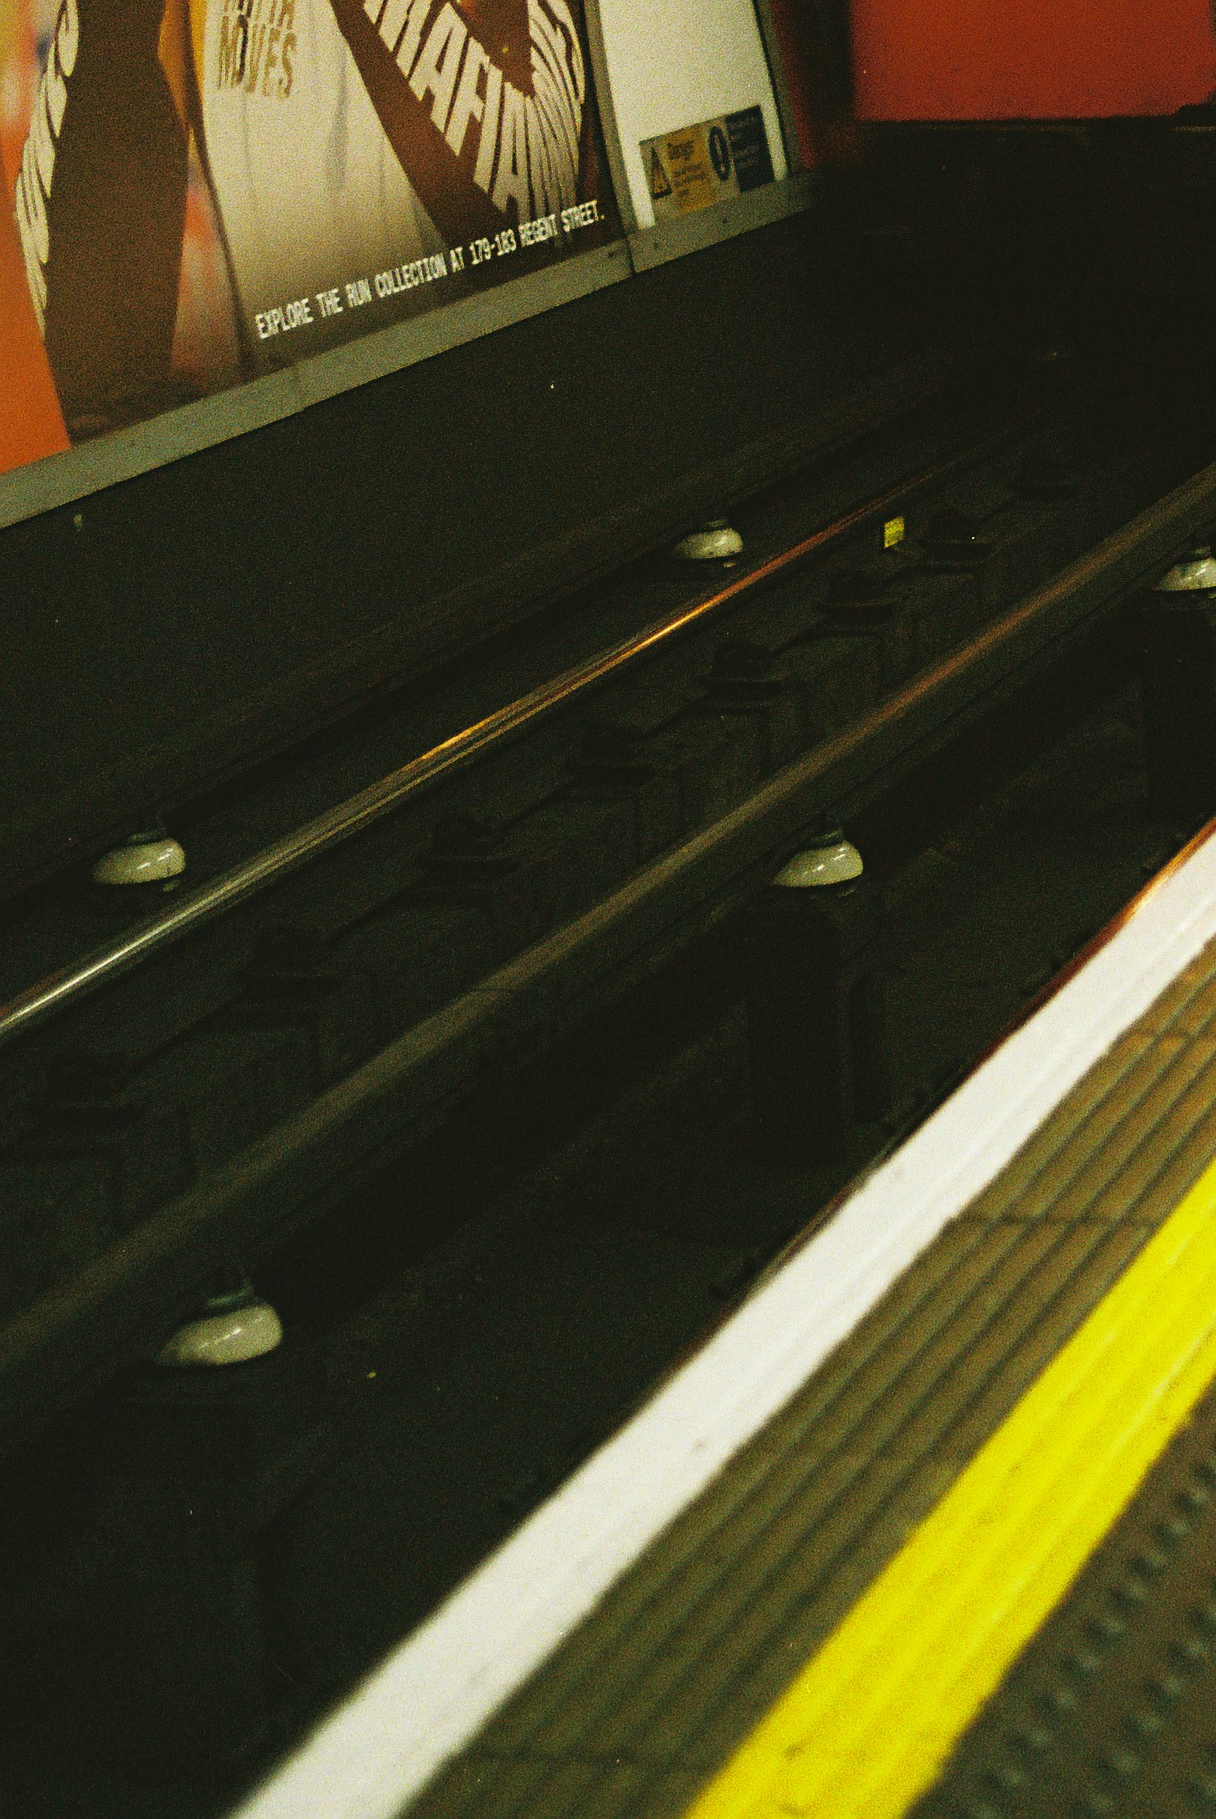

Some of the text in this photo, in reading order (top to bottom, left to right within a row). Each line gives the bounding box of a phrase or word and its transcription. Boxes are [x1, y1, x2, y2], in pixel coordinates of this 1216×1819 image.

[216, 14, 298, 100] MOVES
[255, 199, 606, 340] EXPLORE THE RUN COLLECTION AT 179-183 REGENT STREET.
